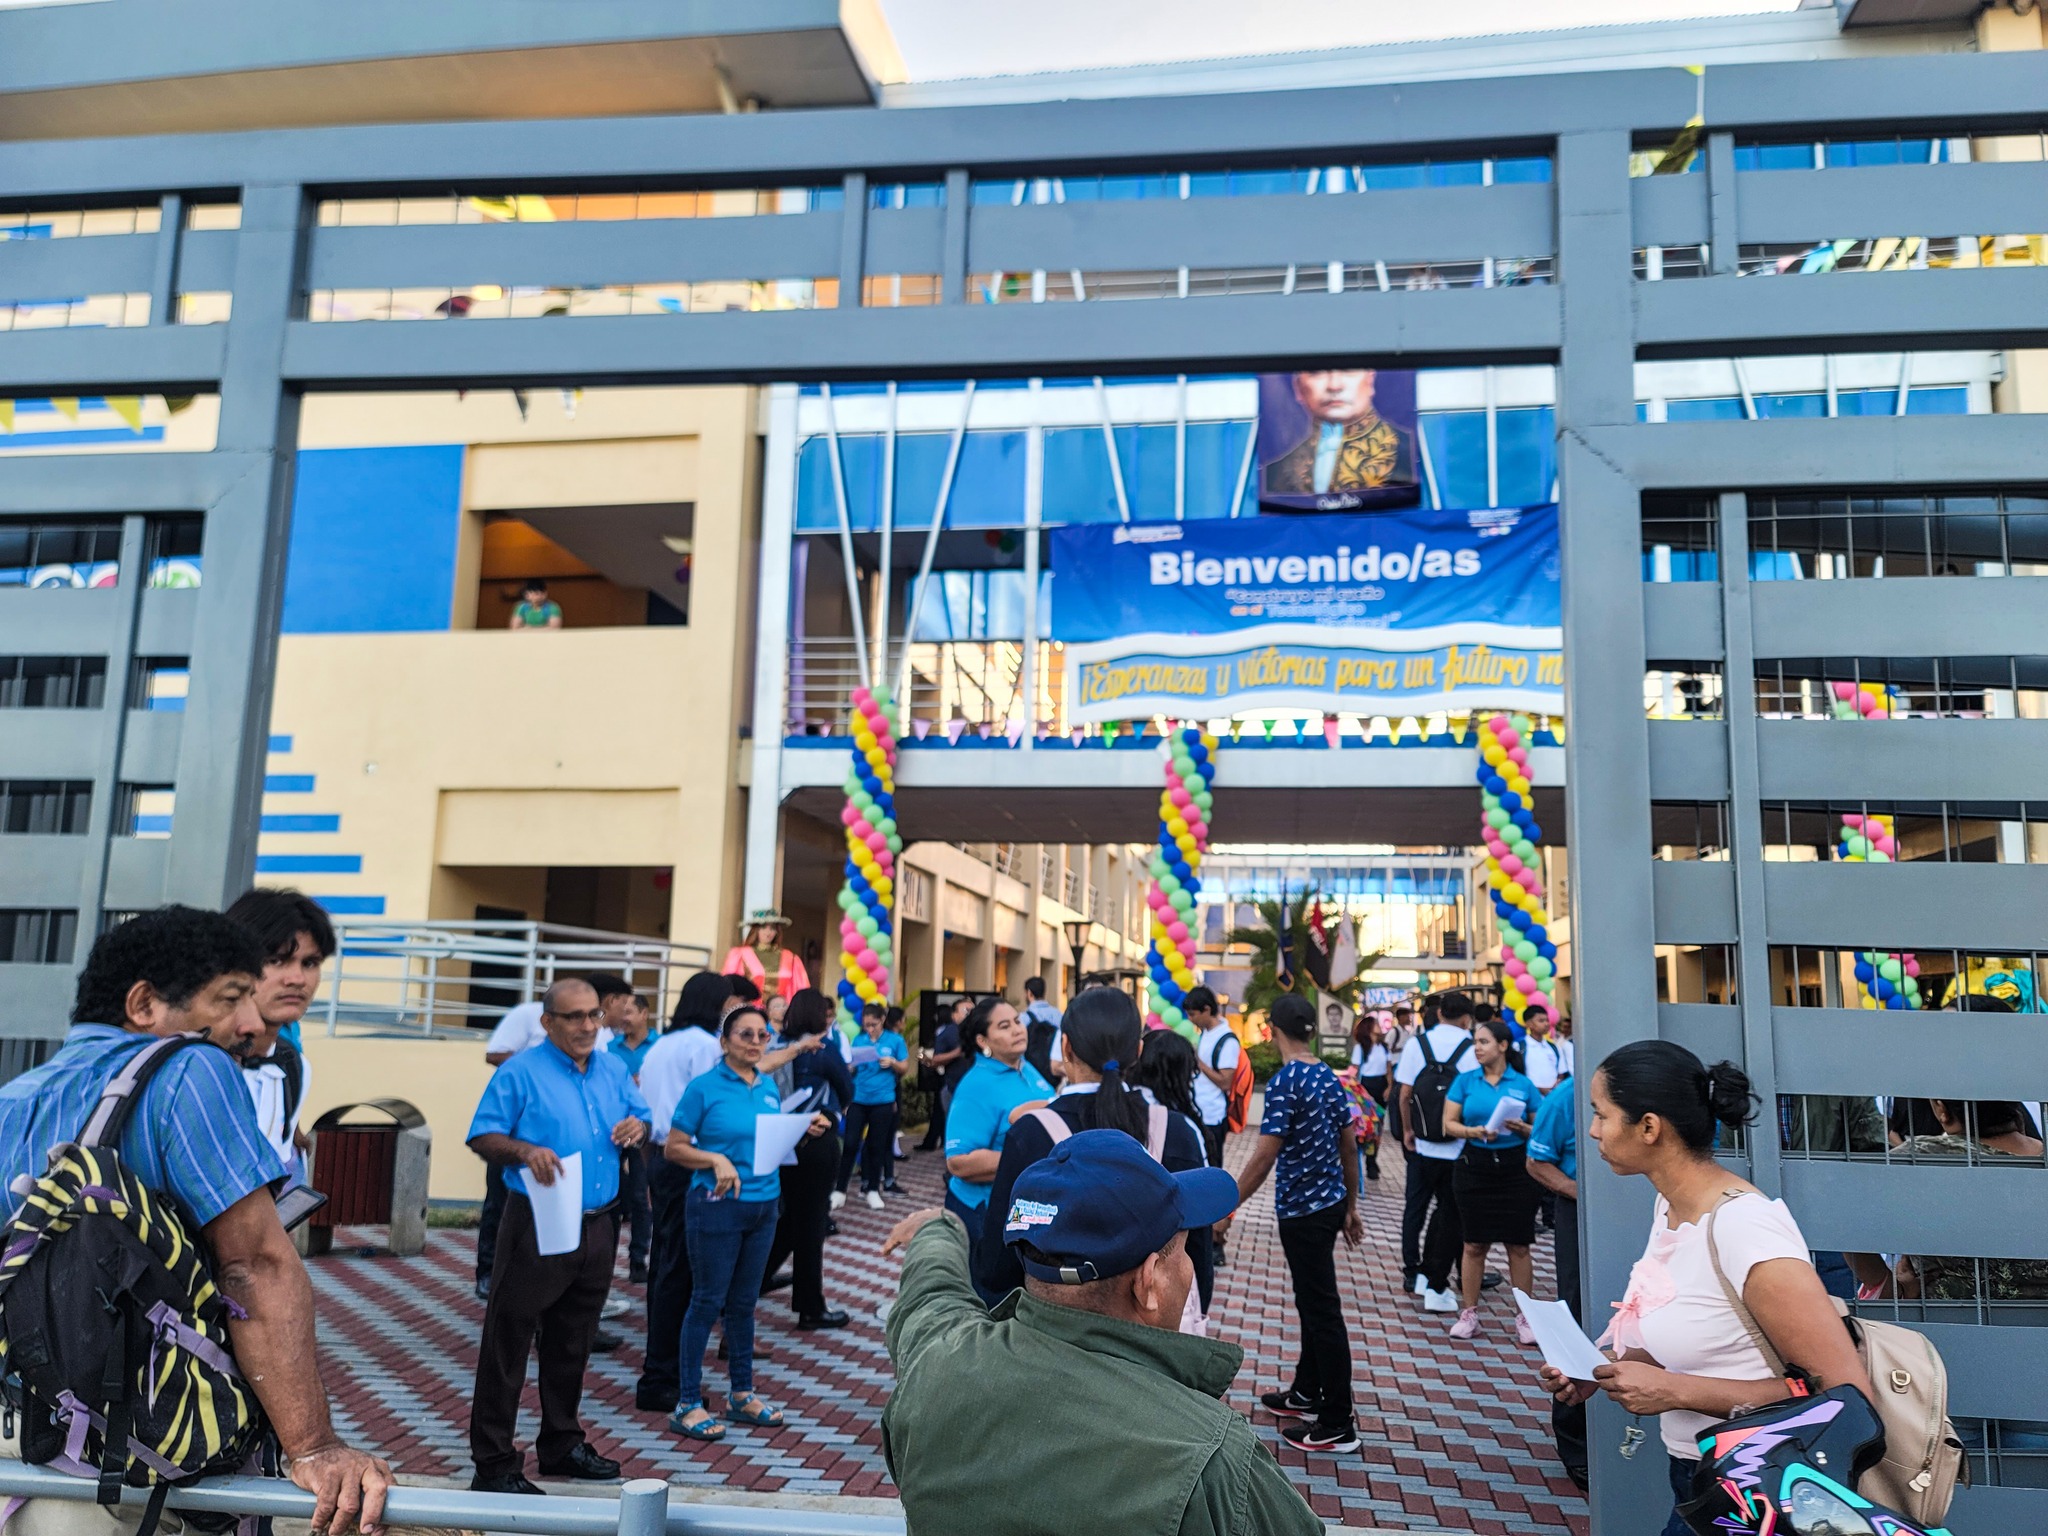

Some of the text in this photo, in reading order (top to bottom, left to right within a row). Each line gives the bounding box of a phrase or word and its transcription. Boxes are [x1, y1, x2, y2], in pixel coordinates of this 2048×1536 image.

[1150, 543, 1482, 585] Bienvenido/as
[1216, 665, 1230, 694] y
[1238, 647, 1328, 687] victorias
[1336, 659, 1397, 693] para
[1404, 658, 1436, 687] un
[1441, 644, 1528, 692] futuro
